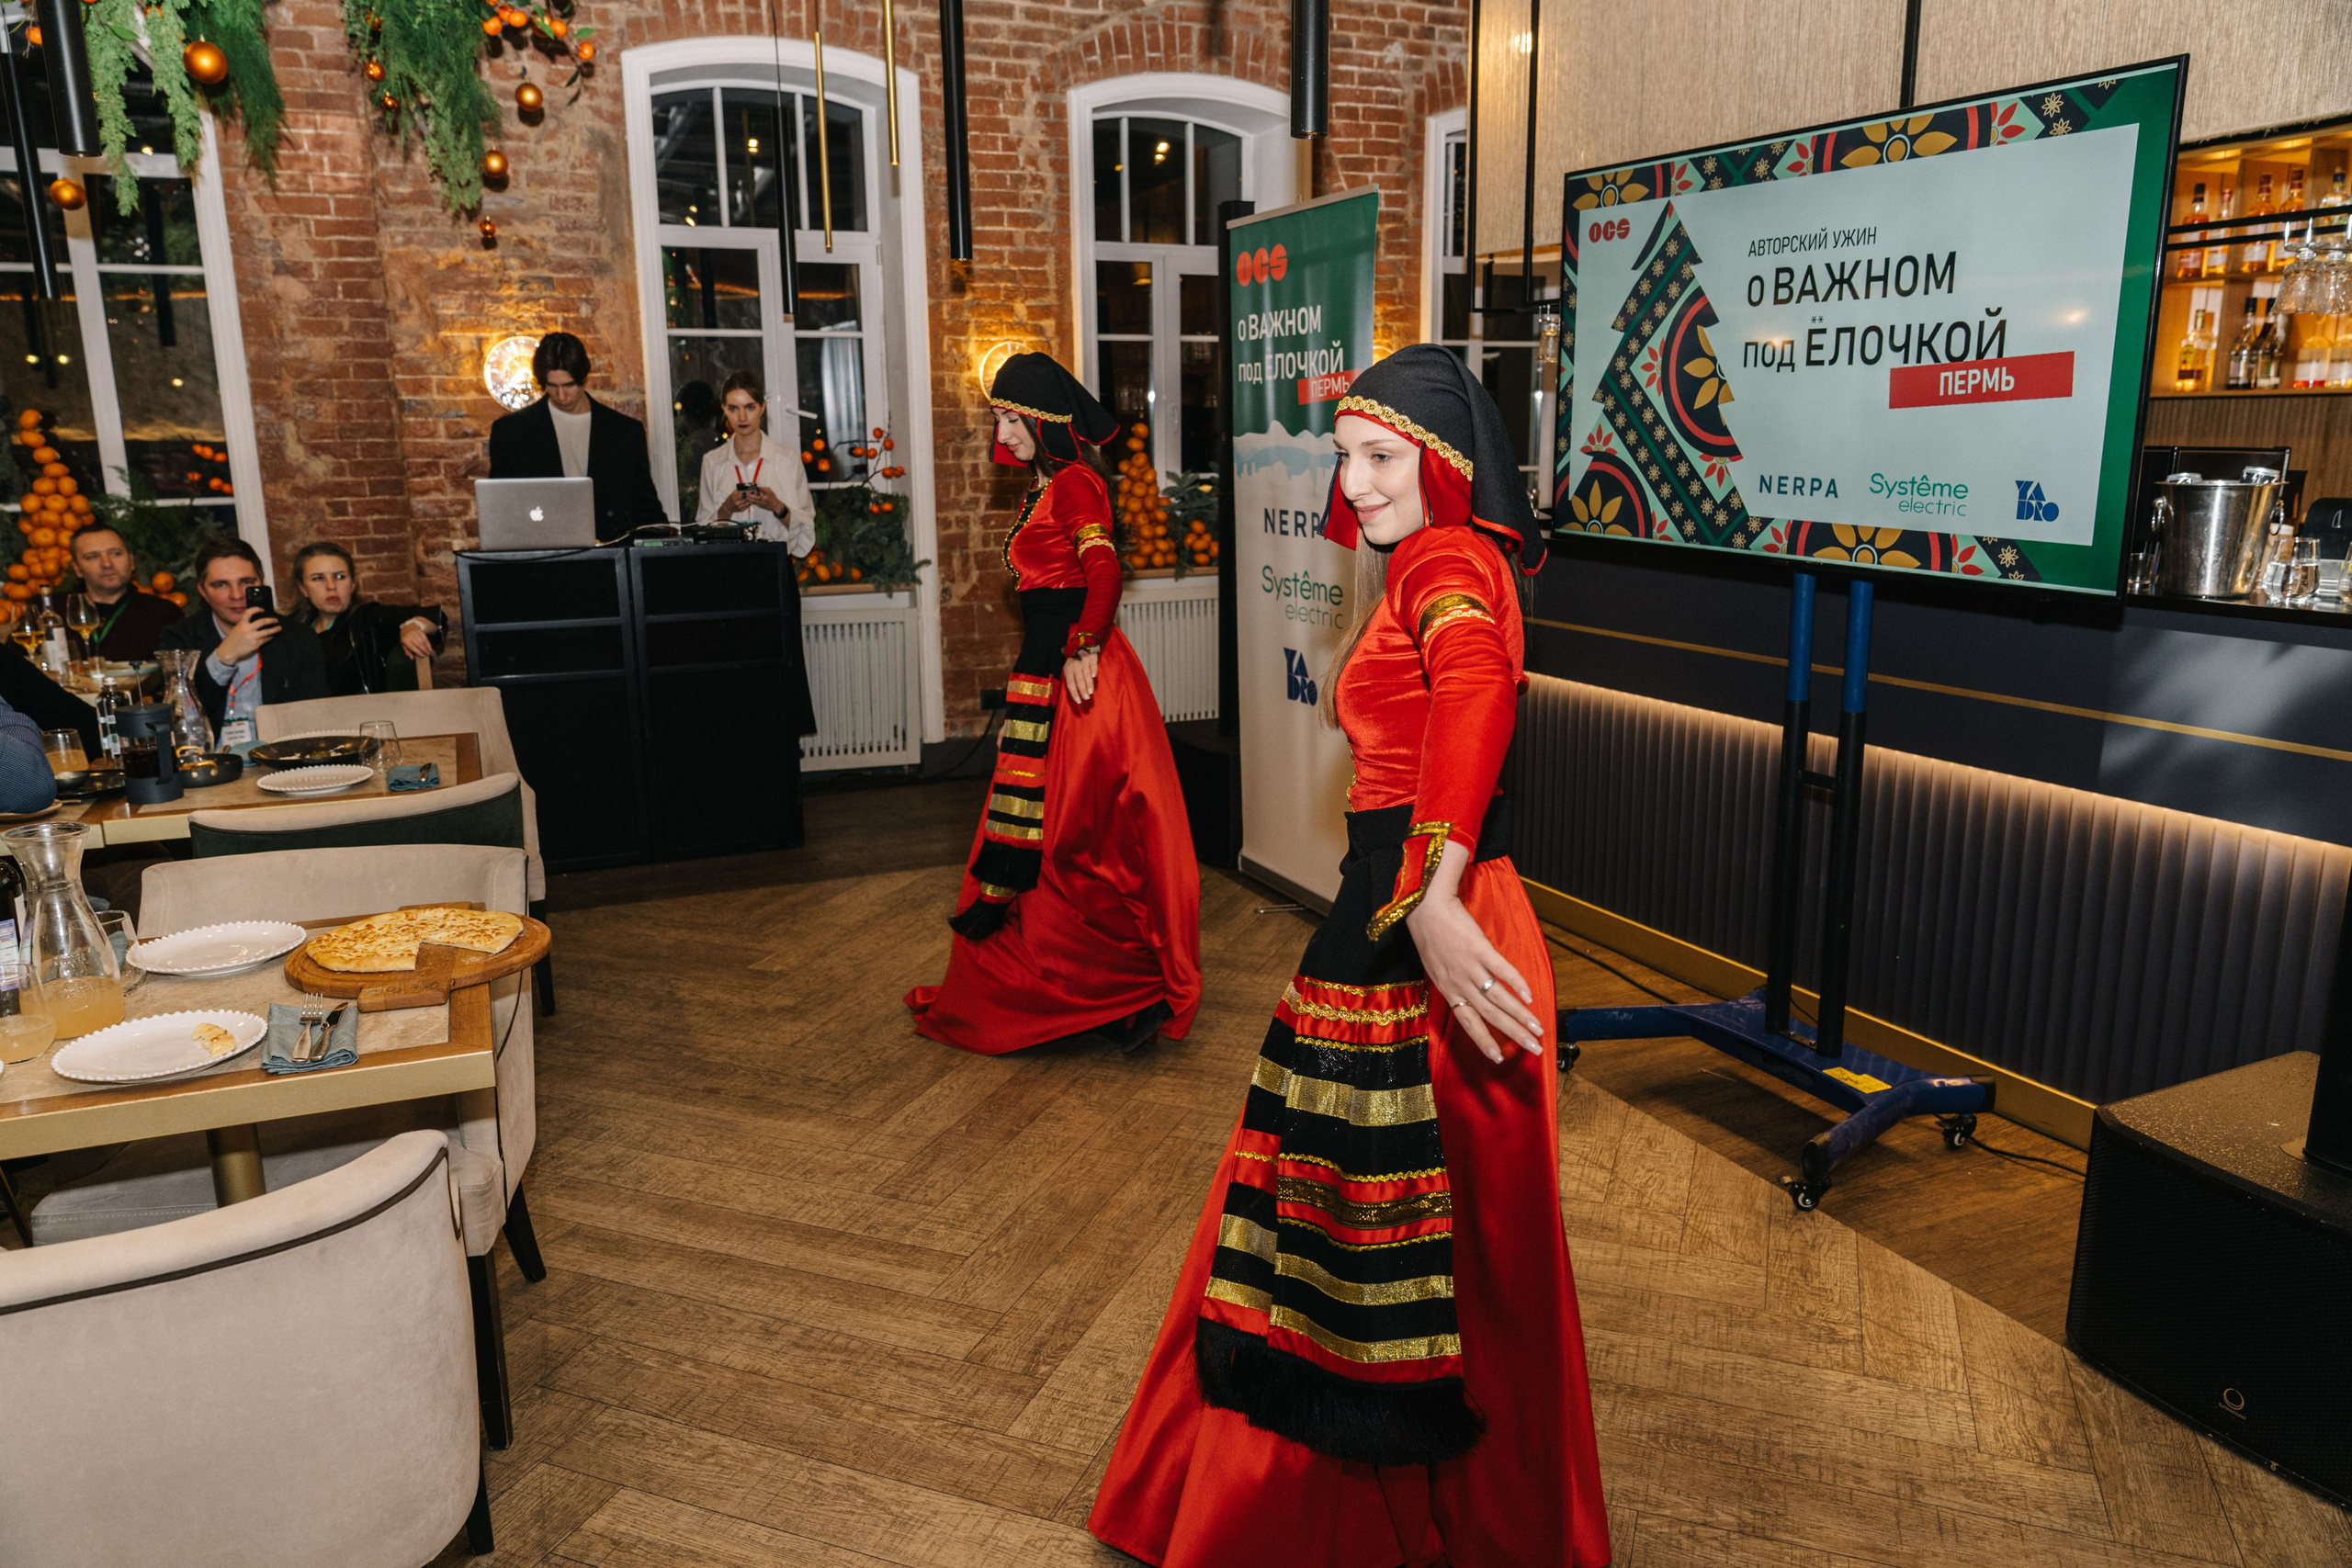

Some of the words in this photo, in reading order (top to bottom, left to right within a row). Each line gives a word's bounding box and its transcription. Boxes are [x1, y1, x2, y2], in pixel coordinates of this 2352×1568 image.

[1589, 218, 1631, 243] OCS
[1748, 227, 1827, 257] АВТОРСКИЙ
[1833, 226, 1877, 249] УЖИН
[1236, 243, 1287, 287] OCS
[1773, 251, 1957, 305] ВАЖНОМ
[1249, 305, 1321, 340] ВАЖНОМ
[1805, 307, 2007, 367] ЁЛОЧКОЙ
[1265, 341, 1344, 380] ЁЛОЧКОЙ
[1310, 376, 1351, 399] ПЕРМЬ
[1939, 367, 2015, 396] ПЕРМЬ
[1758, 475, 1838, 499] NERPA
[1869, 472, 1969, 500] Systême
[1898, 497, 1967, 517] electric
[1263, 508, 1328, 540] NERP
[1261, 565, 1343, 606] Systême
[1285, 601, 1344, 630] electric
